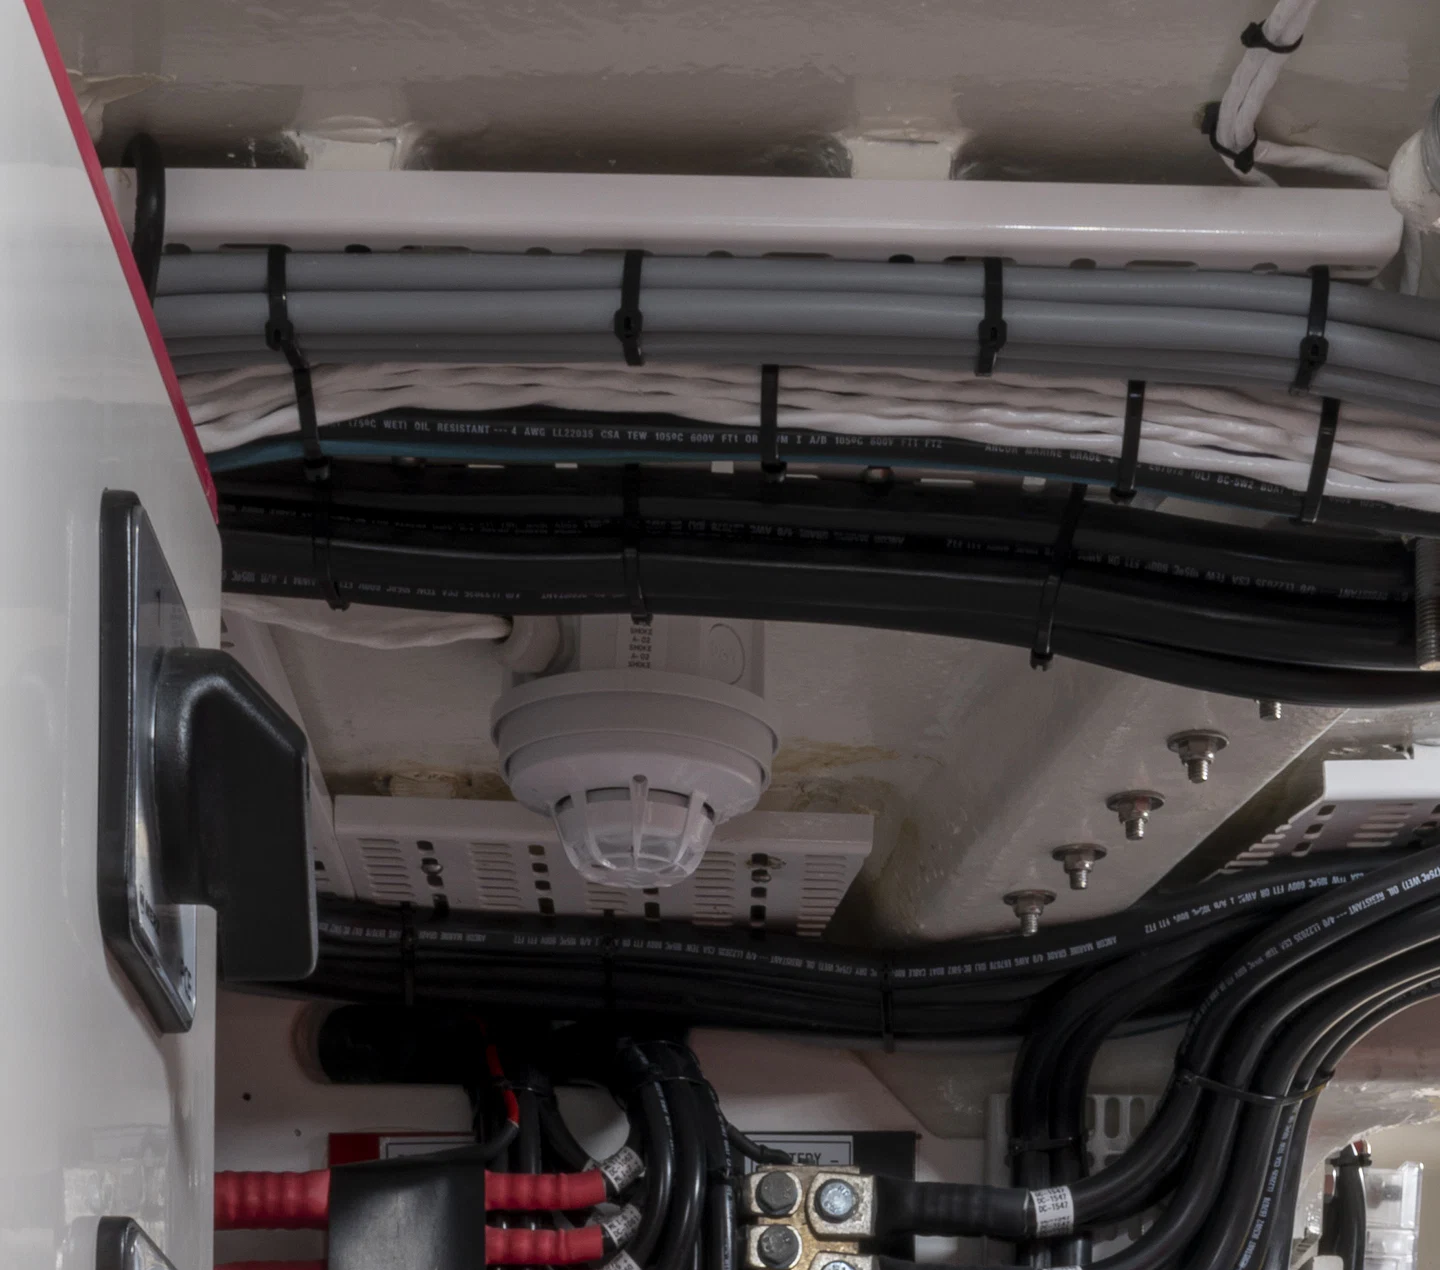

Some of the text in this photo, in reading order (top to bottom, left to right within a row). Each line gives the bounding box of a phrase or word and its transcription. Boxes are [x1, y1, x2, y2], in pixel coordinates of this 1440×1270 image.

[414, 420, 430, 431] OIL
[437, 422, 490, 435] RESISTANT
[524, 428, 546, 437] AWG
[600, 430, 620, 440] CSA
[628, 431, 647, 441] TEW
[690, 433, 714, 443] 600V
[745, 434, 758, 444] OR
[1036, 1194, 1067, 1205] DC-1547
[1038, 1202, 1068, 1213] DC-1547
